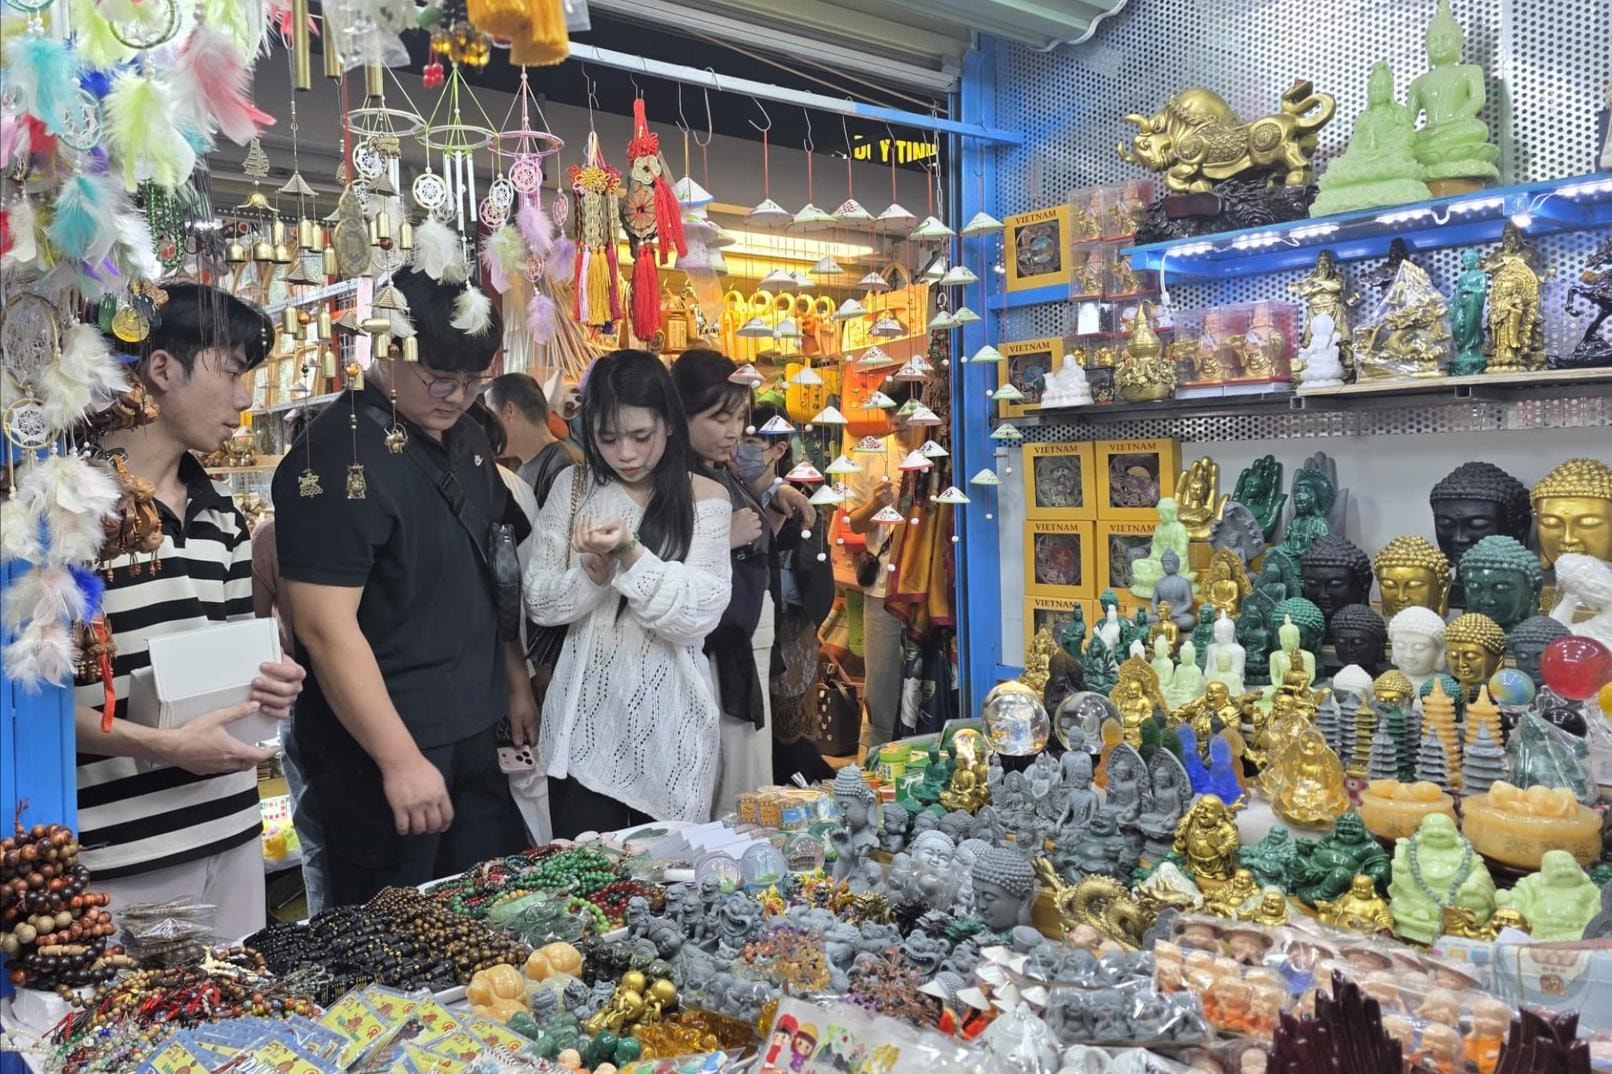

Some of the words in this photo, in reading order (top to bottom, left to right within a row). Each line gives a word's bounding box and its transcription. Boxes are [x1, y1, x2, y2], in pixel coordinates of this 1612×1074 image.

[1015, 209, 1057, 225] VIETNAM
[1009, 341, 1050, 353] VIETNAM
[1034, 445, 1078, 454] VIETNAM
[1109, 442, 1156, 452] VIETNAM
[1035, 523, 1079, 532] VIETNAM
[1109, 524, 1155, 533] VIETNAM
